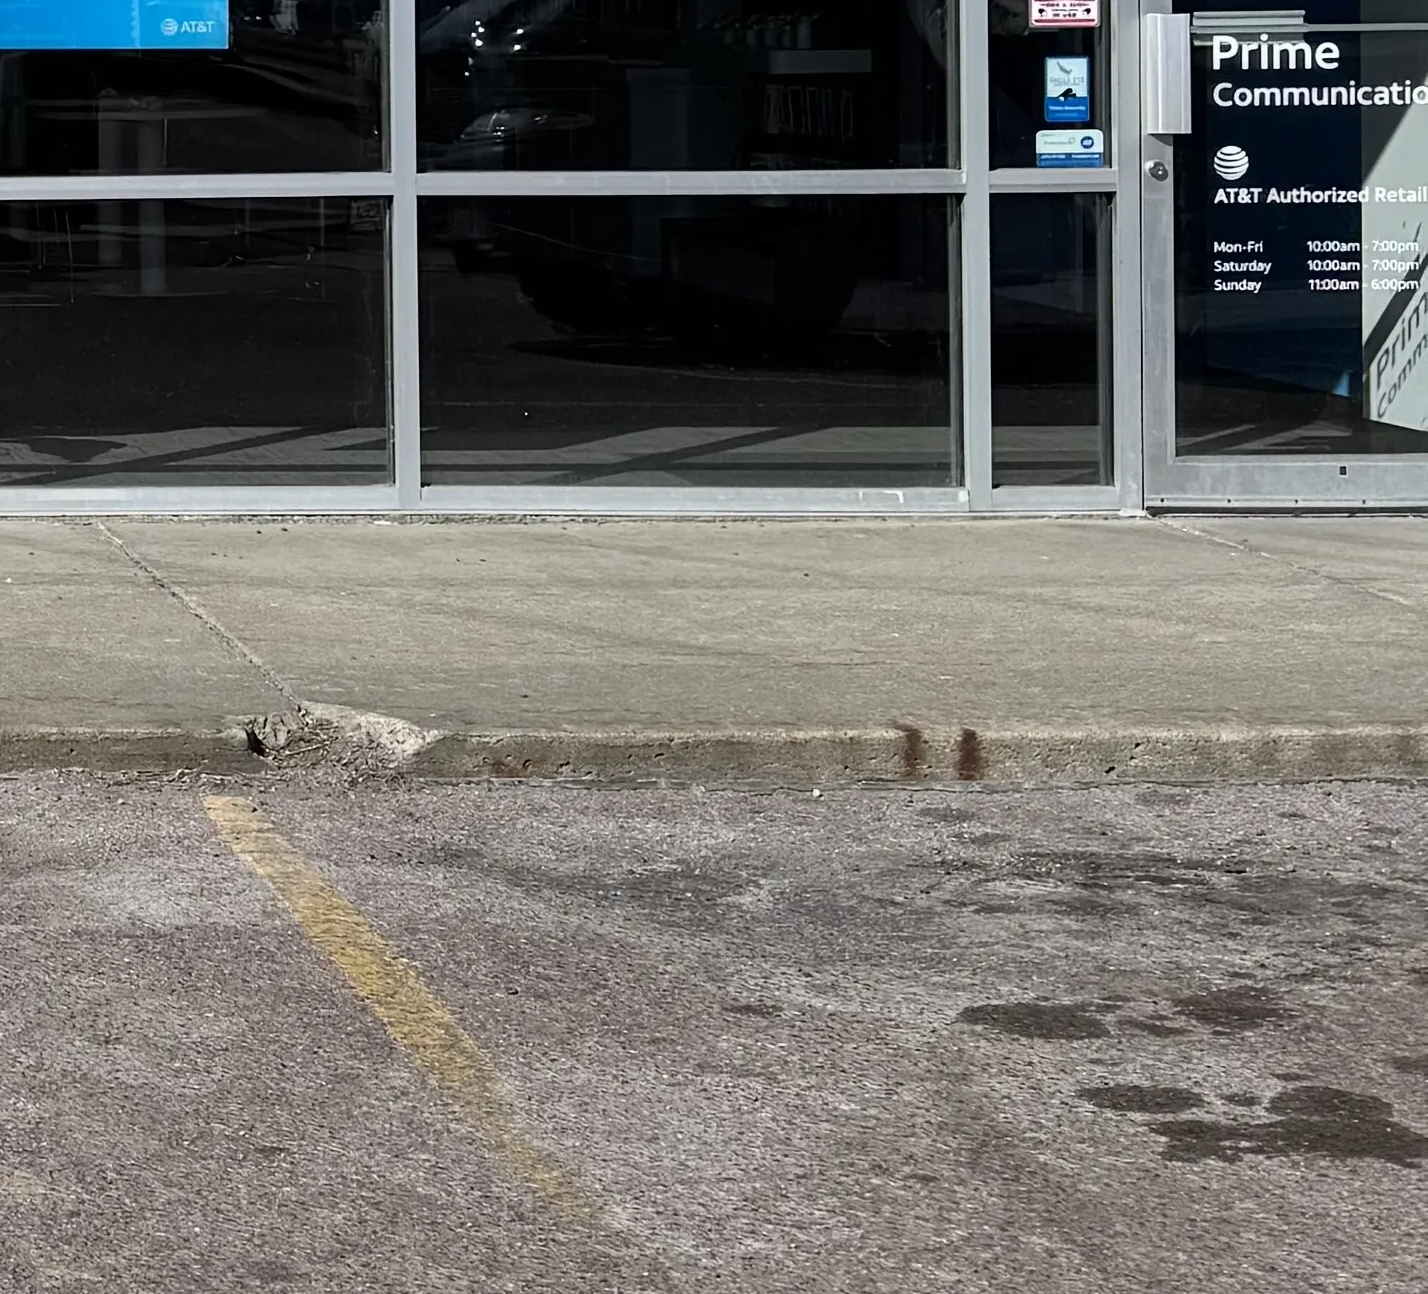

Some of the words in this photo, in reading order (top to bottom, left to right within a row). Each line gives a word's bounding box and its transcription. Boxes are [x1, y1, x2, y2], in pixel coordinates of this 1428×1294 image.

[180, 20, 215, 34] AT&T
[1212, 33, 1340, 70] Prime
[1212, 80, 1428, 107] Communicatio
[1213, 187, 1263, 204] AT&T
[1266, 186, 1369, 204] Authorized
[1374, 186, 1428, 203] Retail
[1213, 240, 1264, 253] Mon-Fri
[1306, 240, 1361, 252] 10:00am
[1371, 240, 1419, 255] 7:00pm
[1213, 260, 1272, 275] Saturday
[1306, 259, 1361, 271] 10:00am
[1371, 259, 1419, 274] 7:00pm
[1213, 279, 1262, 293] Sunday
[1308, 279, 1360, 290] 11:00am
[1371, 278, 1419, 293] 6:00pm
